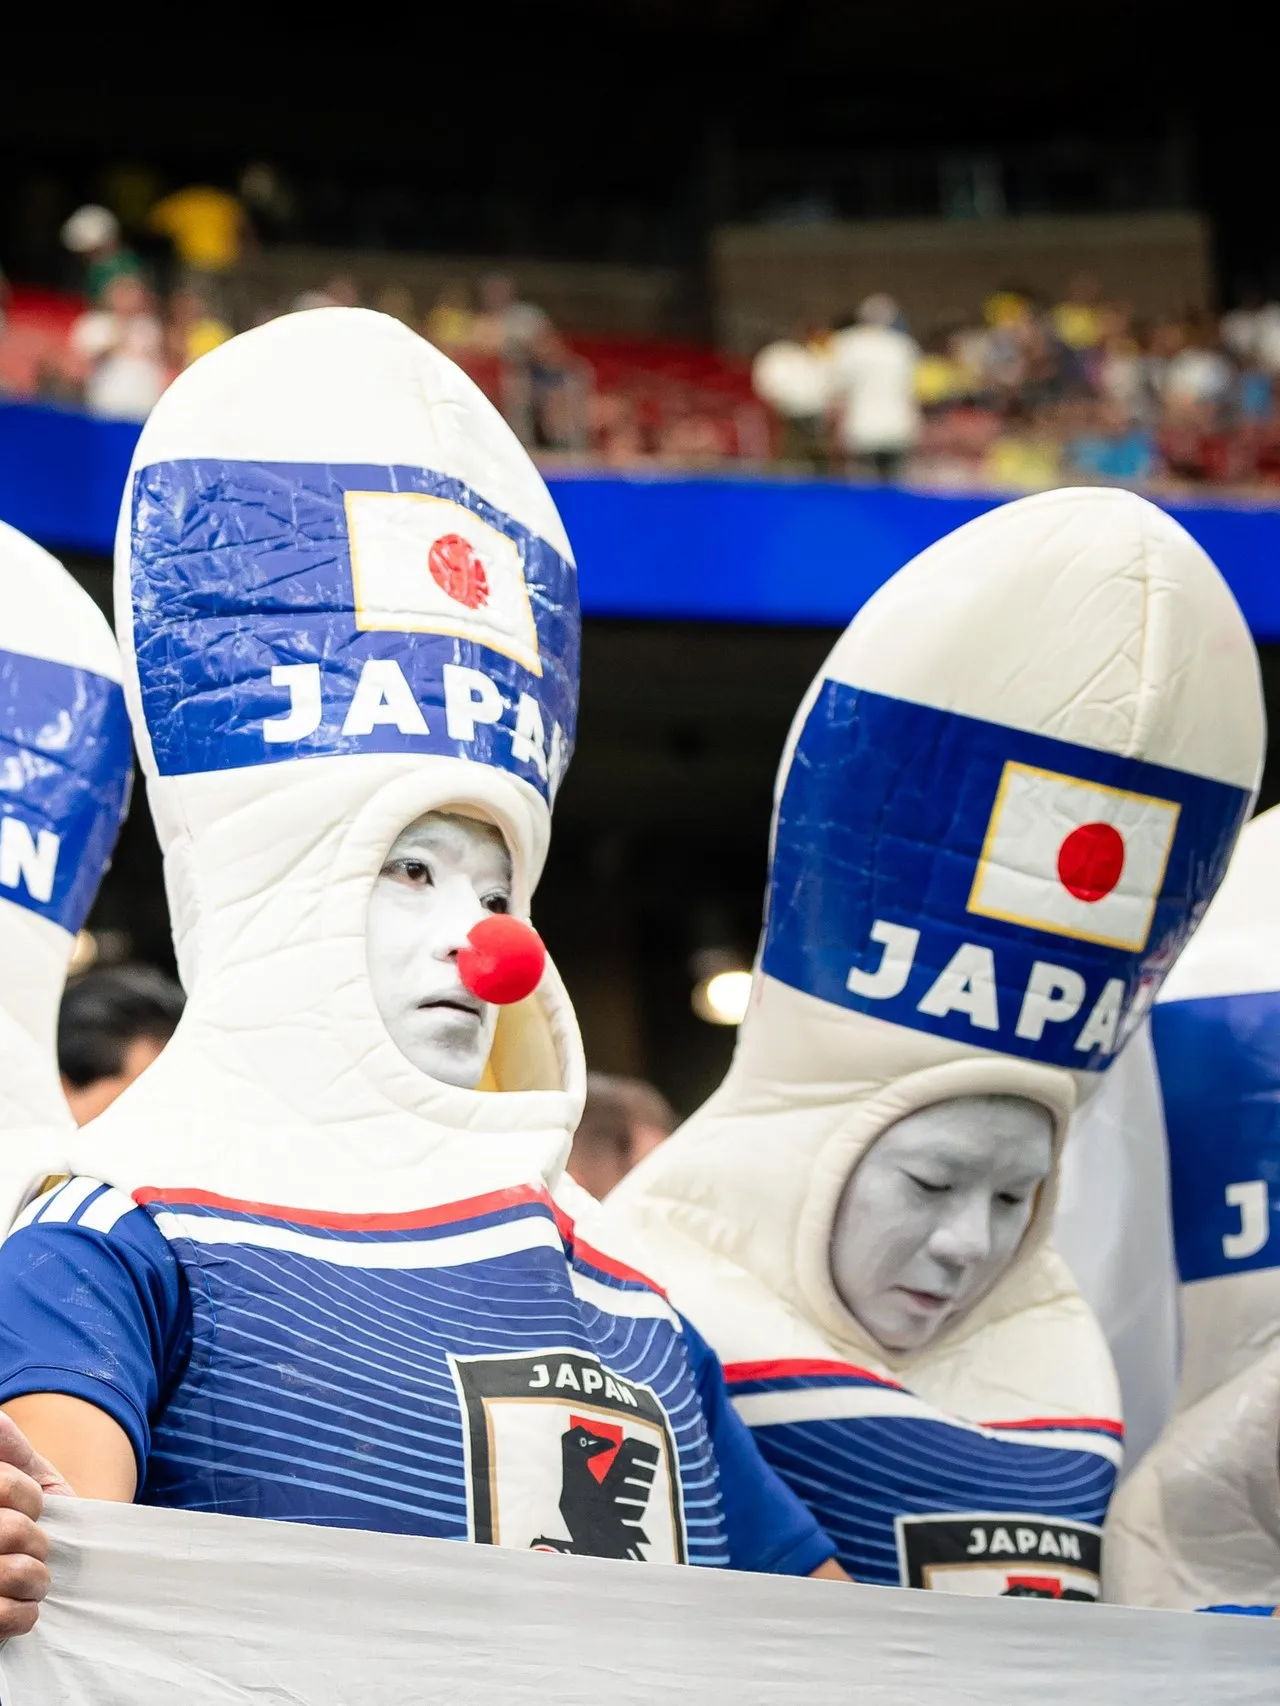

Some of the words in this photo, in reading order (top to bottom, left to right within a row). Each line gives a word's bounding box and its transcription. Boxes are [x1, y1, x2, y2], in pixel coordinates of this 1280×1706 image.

[846, 919, 1148, 1055] JAPA
[529, 1363, 638, 1408] JAPAN
[966, 1527, 1082, 1560] JAPAN
